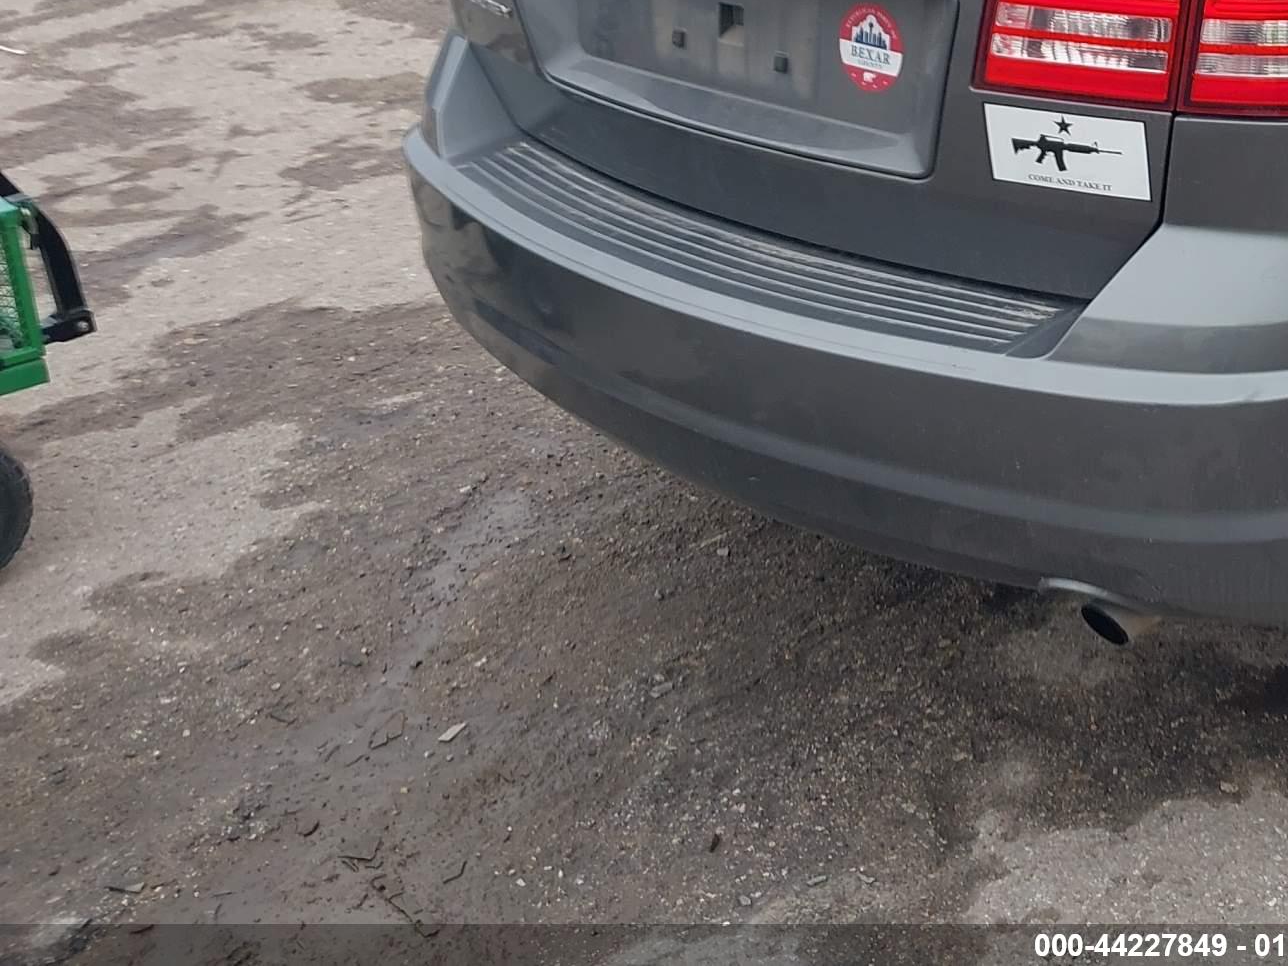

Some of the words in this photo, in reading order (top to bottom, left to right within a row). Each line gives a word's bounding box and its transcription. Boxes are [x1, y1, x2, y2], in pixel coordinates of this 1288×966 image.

[851, 45, 891, 65] BEXAR
[1028, 173, 1055, 184] COME
[1056, 177, 1076, 186] AND
[1076, 180, 1101, 191] TAKE
